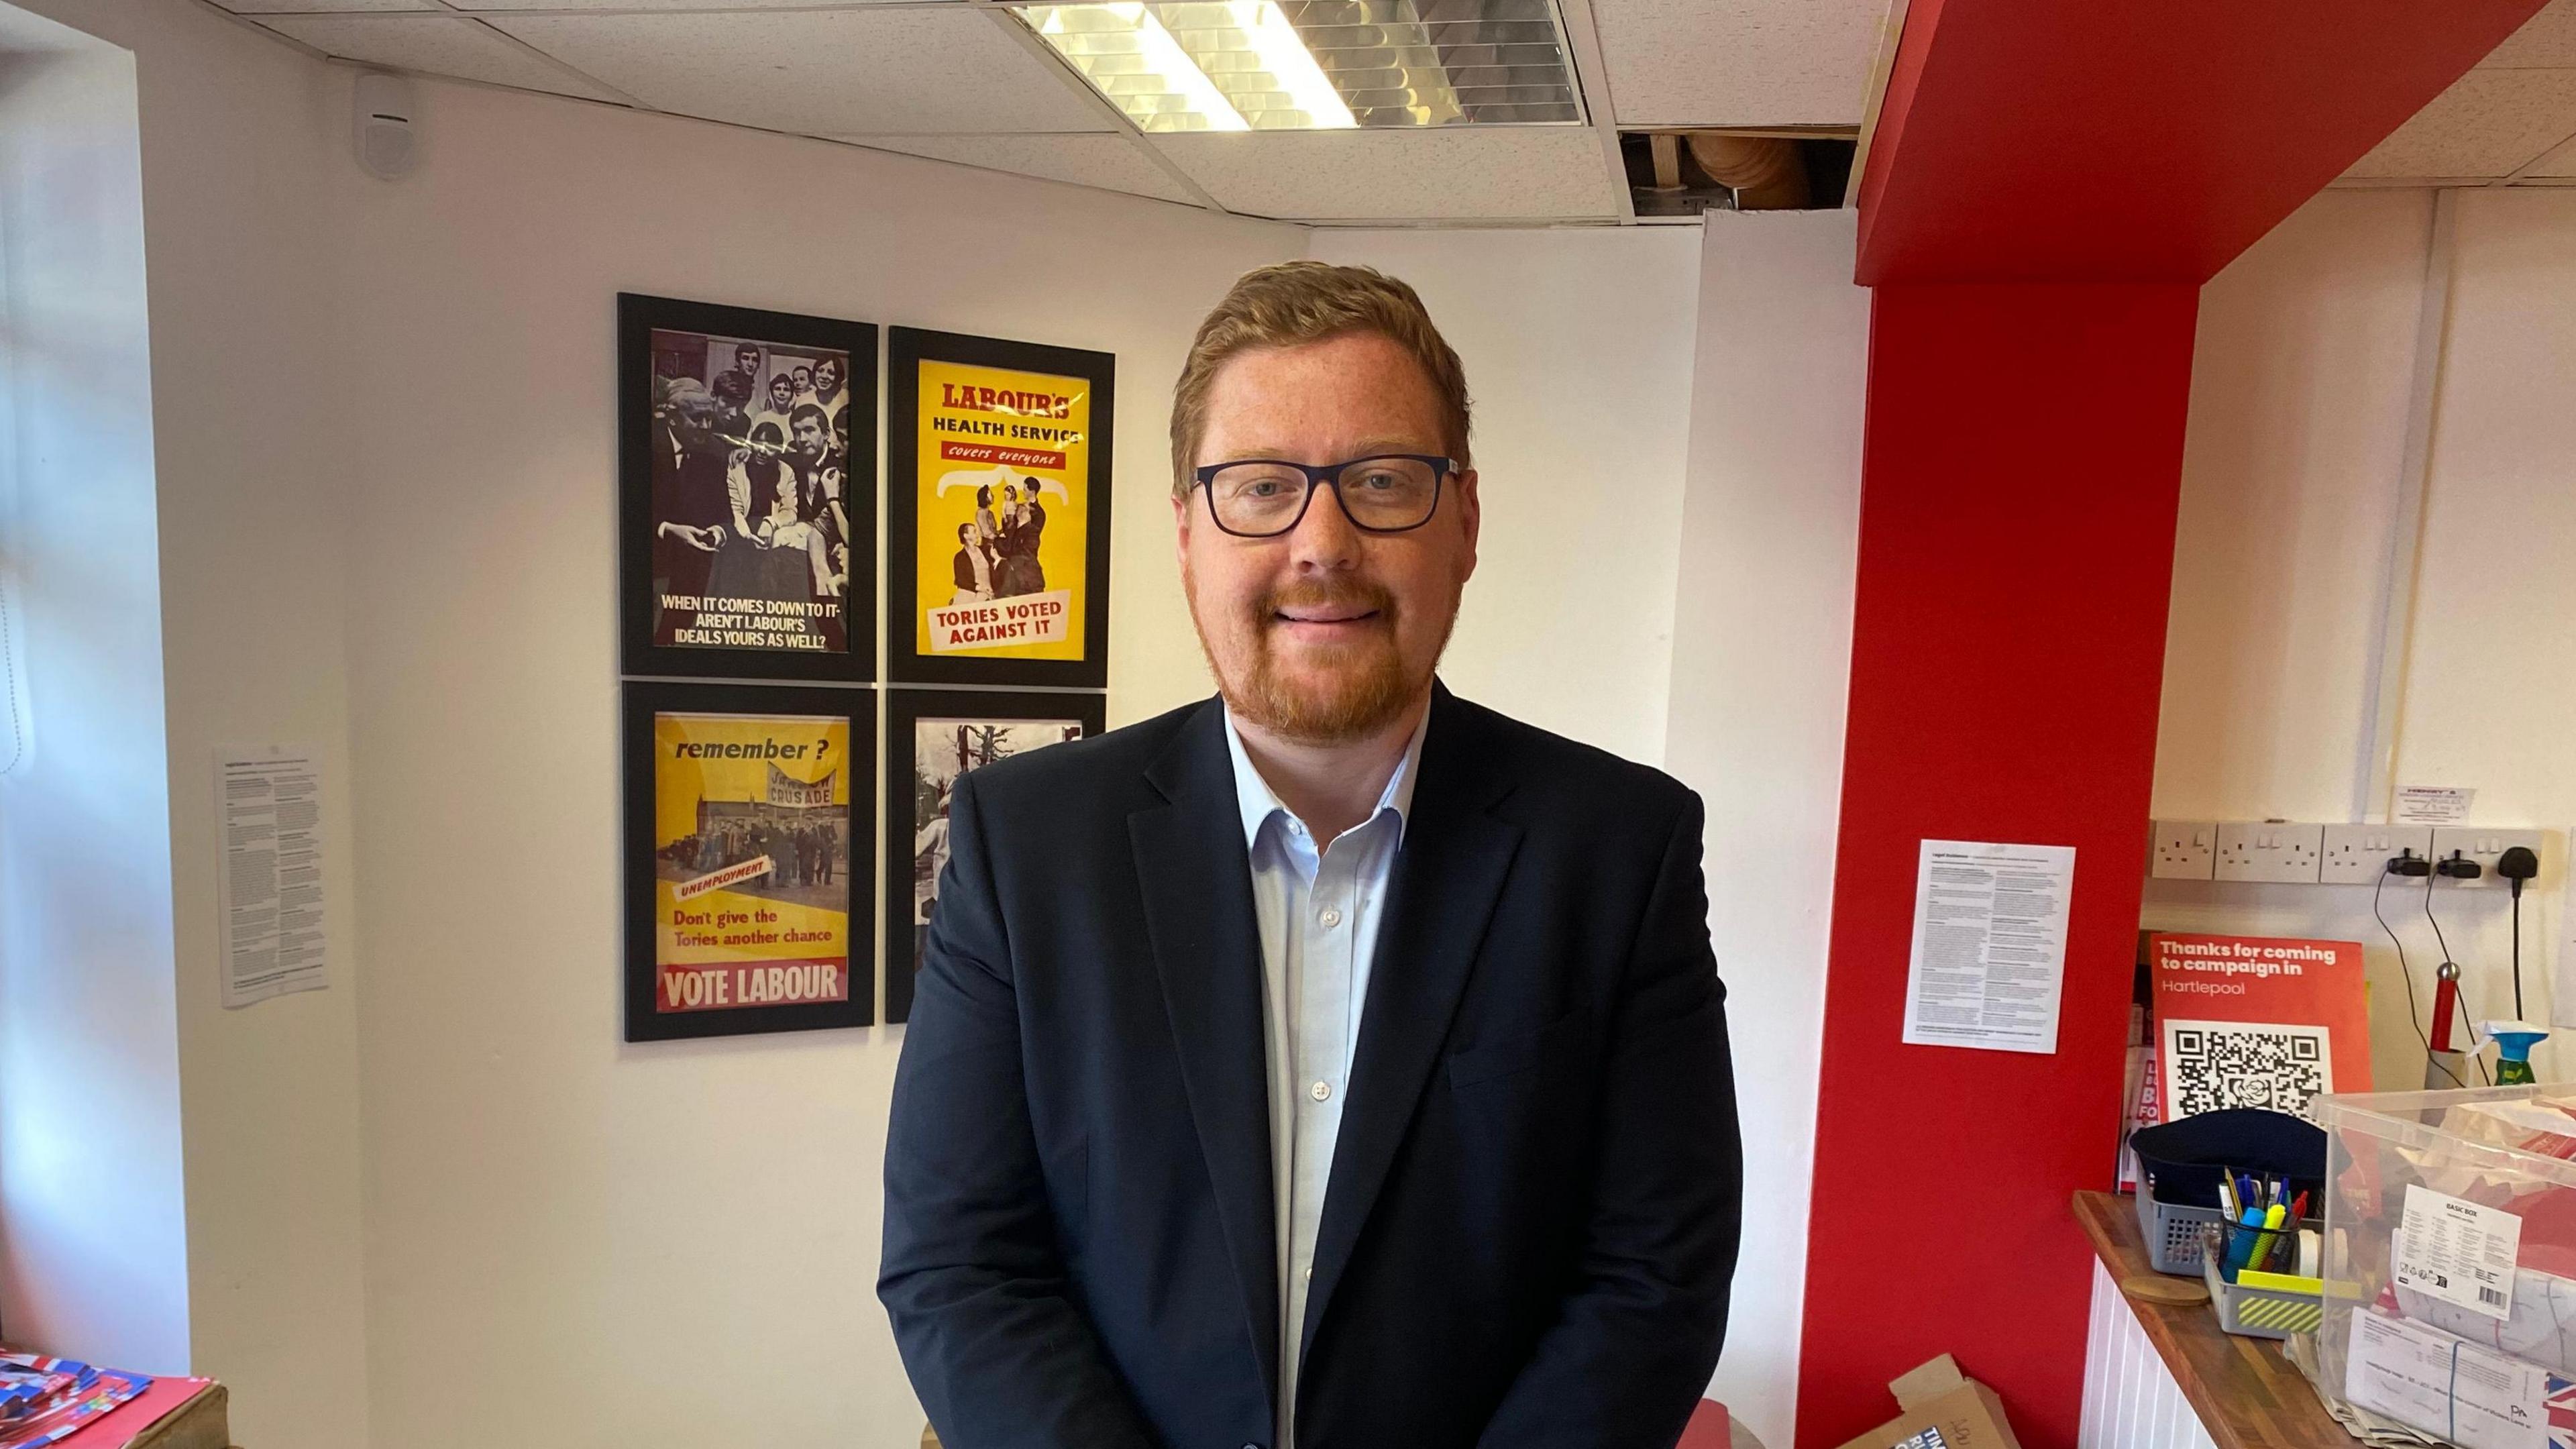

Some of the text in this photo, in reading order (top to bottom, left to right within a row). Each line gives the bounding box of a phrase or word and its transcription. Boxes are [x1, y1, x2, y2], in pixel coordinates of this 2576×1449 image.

[942, 383, 1069, 419] LABOUR'S
[933, 417, 1005, 436] HEALTH
[949, 446, 1056, 465] covers everyone
[661, 594, 700, 610] WHEN
[704, 597, 716, 611] IT
[718, 598, 763, 614] COMES
[767, 601, 804, 616] DOWN
[806, 603, 822, 617] TO
[937, 602, 1061, 627] TORIES VOTED
[696, 614, 805, 632] AREN'T LABOUR'S
[950, 620, 1050, 645] AGAINST IT
[675, 629, 826, 649] IDEALS YOURS AS WELL?
[676, 738, 808, 759] remember
[771, 788, 830, 804] CRUSADE
[681, 861, 763, 897] UNEMPLOYMENT
[674, 909, 777, 928] Don't give the
[675, 928, 833, 947] Tories another chance
[2160, 941, 2336, 965] Thanks for coming
[2161, 957, 2302, 978] to campaign in
[664, 964, 838, 1006] VOTE LABOUR
[2162, 980, 2245, 996] Hartlepool
[2139, 1105, 2158, 1118] FO
[2464, 1208, 2477, 1217] BOX
[1925, 1427, 1947, 1449] TIM
